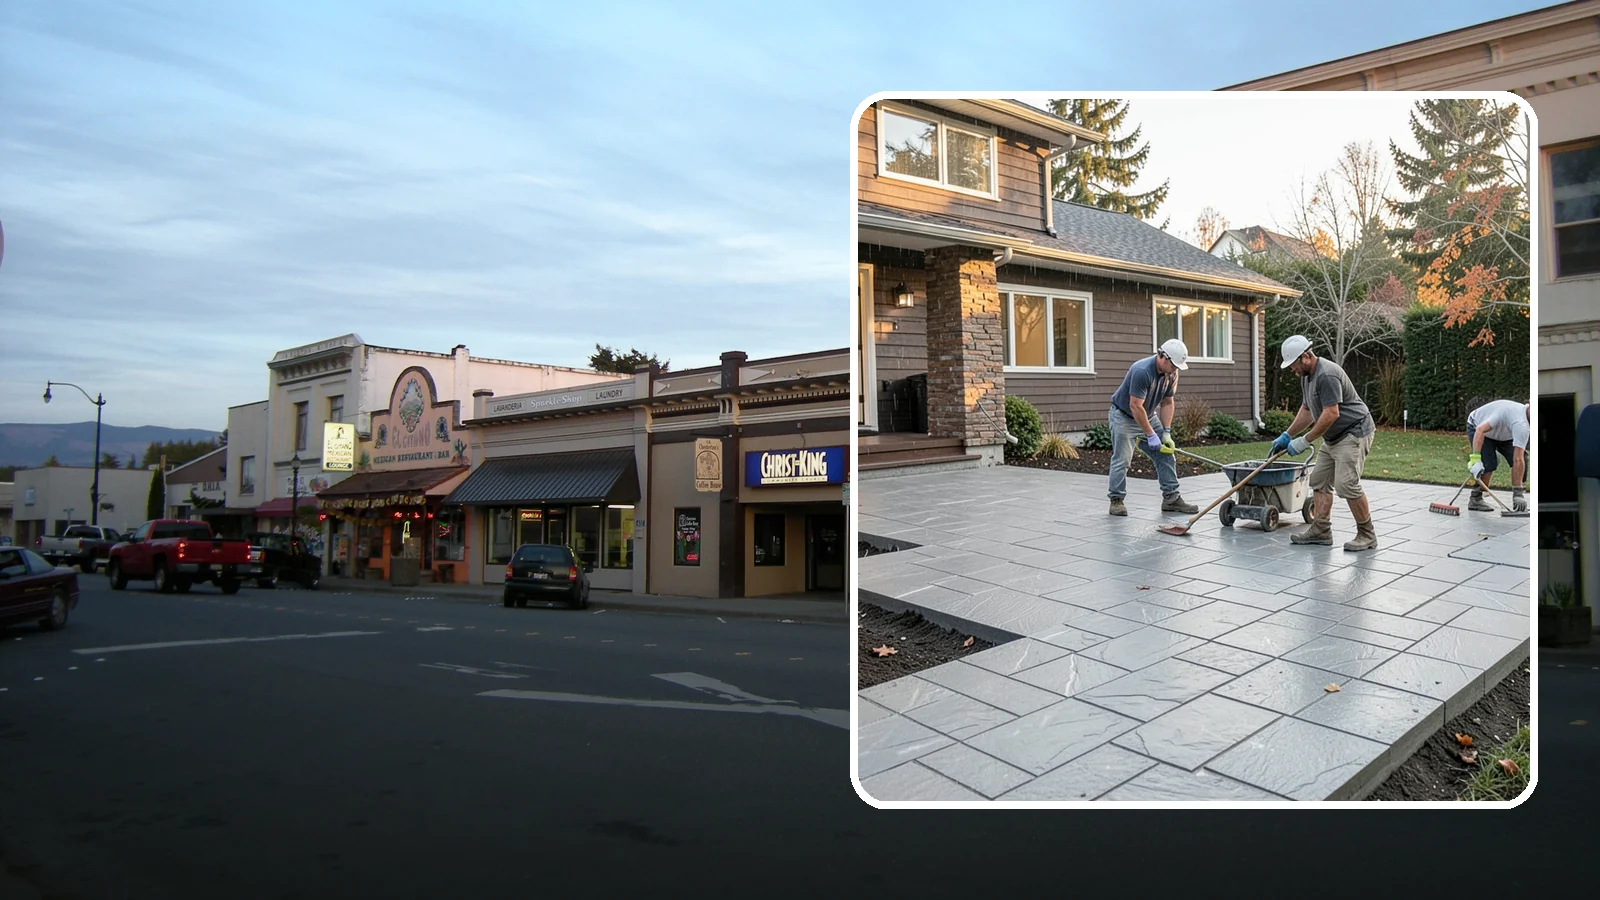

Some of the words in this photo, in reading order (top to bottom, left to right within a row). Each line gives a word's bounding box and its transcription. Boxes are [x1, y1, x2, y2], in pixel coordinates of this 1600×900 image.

[530, 398, 561, 409] Sparkle
[562, 394, 582, 405] Shop
[595, 389, 623, 400] LAUNDRY
[493, 402, 522, 413] LAVANDERIA
[374, 455, 396, 464] MEXICAN
[397, 451, 433, 462] RESTAURANT
[438, 450, 450, 459] BAR
[761, 452, 797, 478] CHRIST
[799, 450, 827, 476] KING
